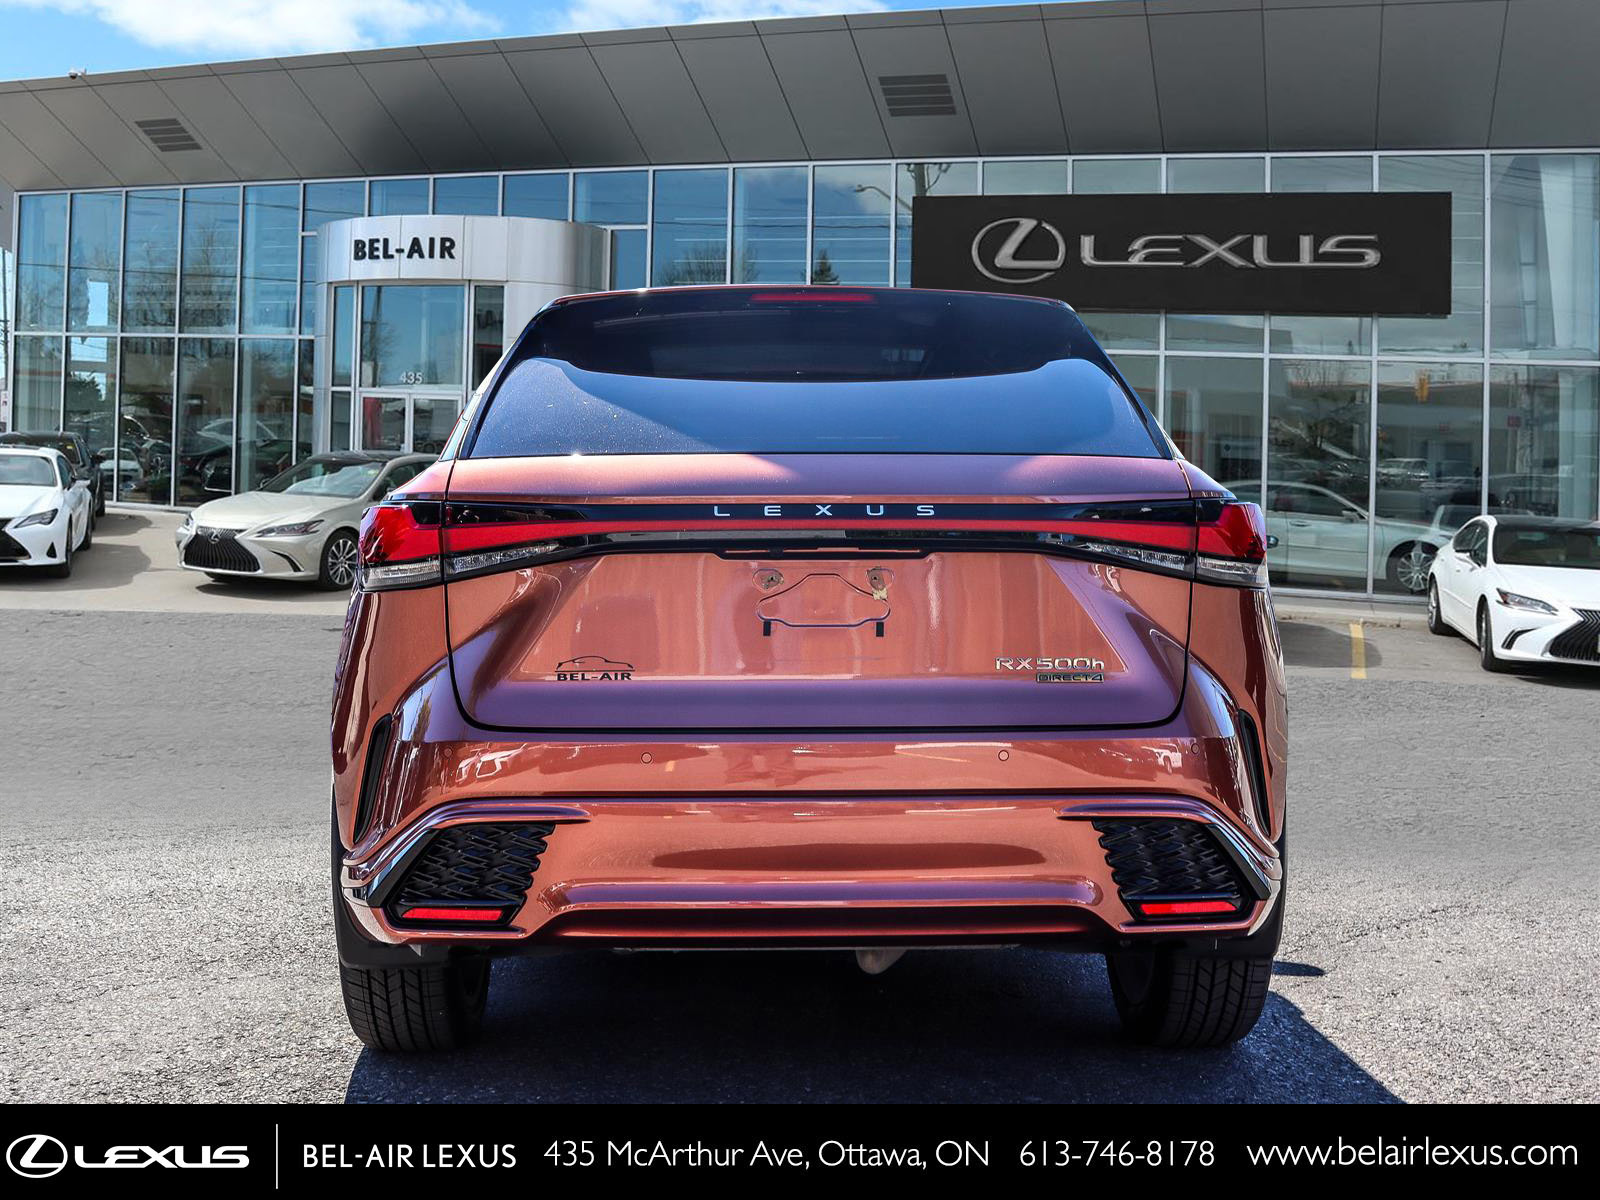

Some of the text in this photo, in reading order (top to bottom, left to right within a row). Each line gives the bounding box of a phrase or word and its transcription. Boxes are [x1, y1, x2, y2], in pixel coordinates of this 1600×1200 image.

[353, 237, 456, 261] BEL-AIR
[1081, 235, 1381, 268] LEXUS
[400, 372, 423, 384] 435
[712, 502, 936, 517] LEXUS
[557, 672, 632, 681] BEL-AIR
[1037, 673, 1104, 682] DIRECT4
